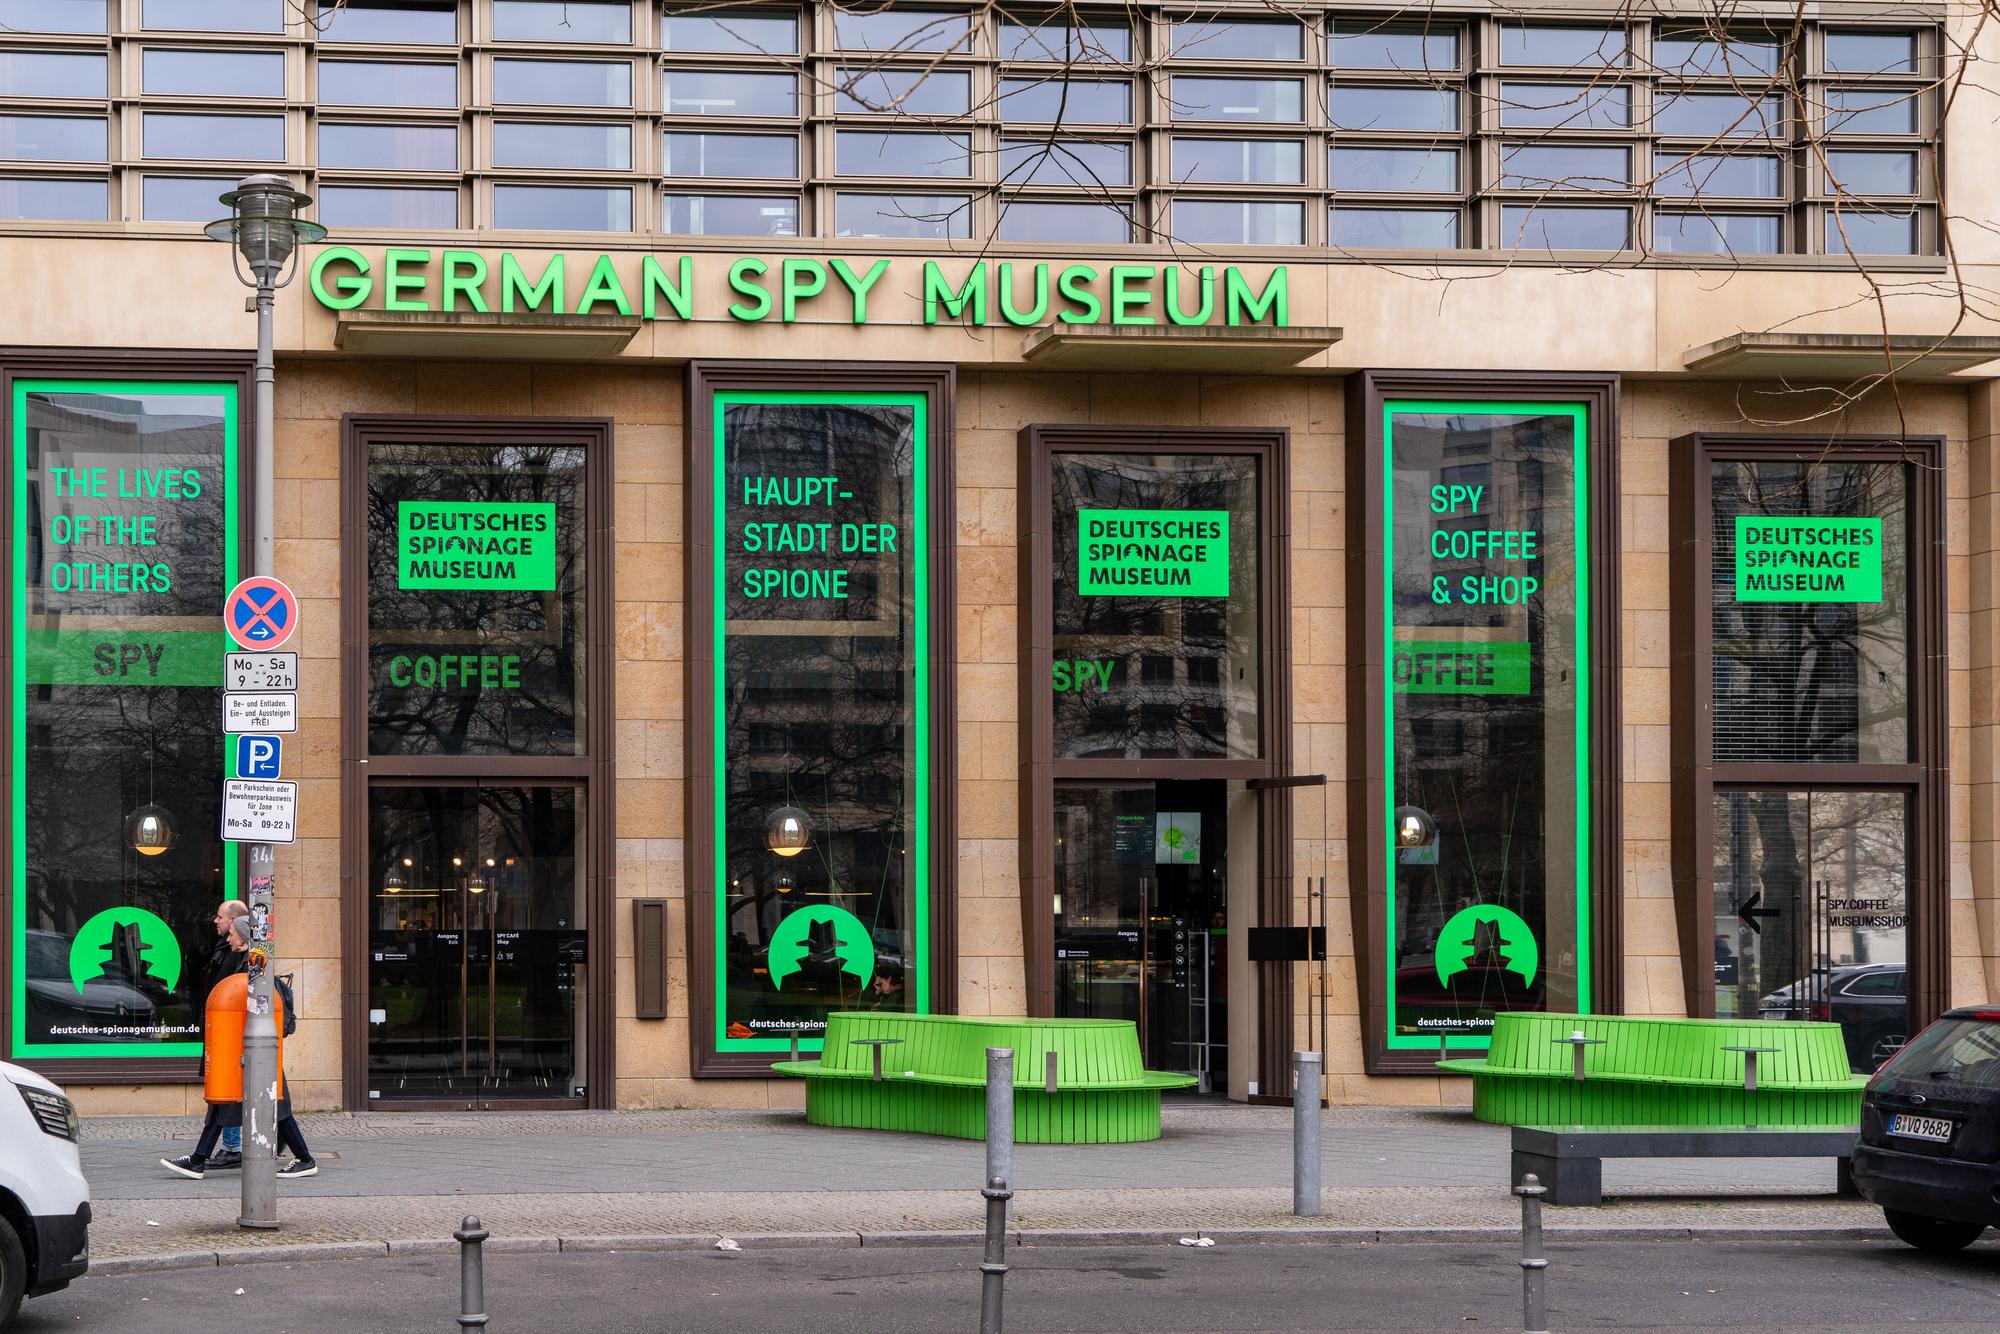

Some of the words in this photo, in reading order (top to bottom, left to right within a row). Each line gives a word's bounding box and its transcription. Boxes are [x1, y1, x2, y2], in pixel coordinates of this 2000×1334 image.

[310, 246, 692, 320] GERMAN
[728, 257, 891, 324] SPY
[923, 261, 1288, 327] MUSEUM
[50, 468, 108, 497] THE
[119, 468, 201, 499] LIVES
[743, 476, 853, 506] HAUPT-
[1430, 484, 1484, 513] SPY
[51, 514, 91, 546] OF
[98, 515, 157, 546] THE
[409, 511, 548, 532] DEUTSCHES
[1088, 519, 1222, 540] DEUTSCHES
[408, 535, 533, 556] SPIONAGE
[743, 522, 832, 552] STADT
[841, 523, 898, 553] DER
[1431, 529, 1537, 560] COFFEE
[1745, 526, 1875, 546] DEUTSCHES
[1088, 543, 1208, 563] SPIONAGE
[1744, 549, 1861, 569] SPIONAGE
[51, 561, 172, 593] OTHERS
[408, 560, 517, 580] MUSEUM
[1088, 566, 1192, 586] MUSEUM
[743, 568, 849, 599] SPIONE
[1431, 575, 1452, 605] &
[1461, 575, 1539, 606] SHOP
[1745, 573, 1846, 592] MUSEUM
[93, 642, 166, 677] SPY
[233, 658, 252, 671] Mo
[269, 658, 286, 670] Sa
[238, 675, 246, 687] 9
[390, 655, 521, 689] COFFEE
[1052, 658, 1115, 694] SPY
[230, 709, 243, 717] Ein-
[245, 709, 256, 717] und
[259, 709, 291, 718] Aussteigen
[233, 699, 244, 707] Be-
[247, 699, 258, 707] und
[251, 718, 270, 726] FREI
[248, 739, 274, 774] P
[228, 791, 292, 802] Bewohnerparkausweis
[231, 783, 242, 791] mit
[243, 783, 275, 792] Parkschein
[276, 785, 290, 793] oder
[247, 802, 256, 810] für
[227, 818, 253, 828] Mo-Sa
[261, 820, 284, 829] 09-22
[285, 821, 290, 830] h
[1829, 915, 1910, 927] MUSEUMSSHOP
[50, 1024, 200, 1035] deutsches-spionagemuseum.de
[1894, 1115, 1903, 1132] B
[1907, 1117, 1922, 1134] VQ
[1921, 1119, 1951, 1138] 9682
